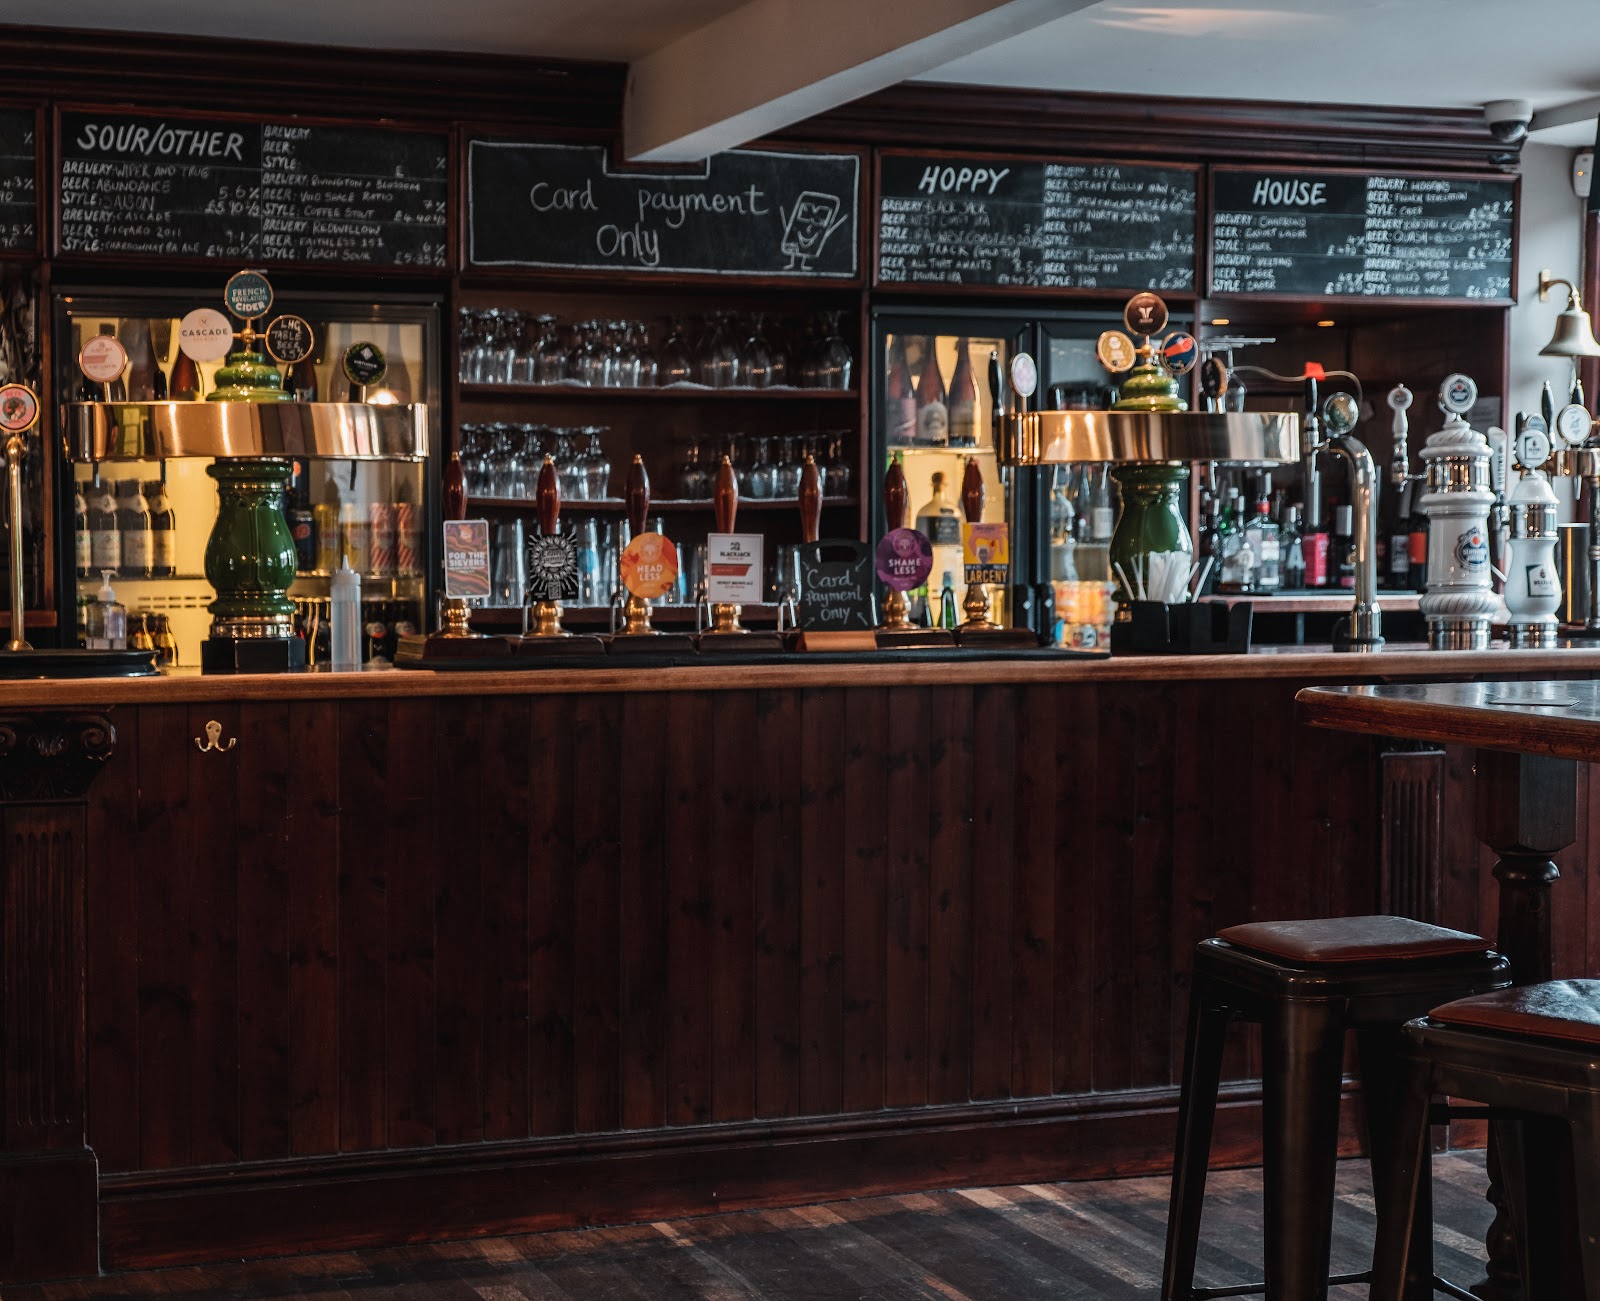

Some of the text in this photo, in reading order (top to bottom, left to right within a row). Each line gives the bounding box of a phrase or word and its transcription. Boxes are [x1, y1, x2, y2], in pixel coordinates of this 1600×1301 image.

[77, 123, 244, 161] SOUR/OTHER
[154, 165, 176, 177] AND
[1092, 167, 1120, 180] DEYA
[918, 165, 1010, 195] HOPPY
[97, 180, 171, 193] ABUNDANCE
[1252, 177, 1327, 206] HOUSE
[362, 190, 394, 202] RATIO
[530, 178, 769, 229] Card payment
[116, 211, 172, 223] CASCADE
[303, 205, 341, 217] COFFEE
[344, 207, 376, 219] STOUT
[156, 226, 182, 239] 2011
[313, 220, 382, 236] REDWILLOW
[1073, 221, 1092, 233] IPA
[182, 241, 201, 253] ALE
[597, 223, 660, 266] Only
[926, 242, 970, 256] TRACK
[306, 247, 338, 259] PEACH
[341, 249, 371, 262] SOUR
[955, 259, 992, 271] AWAITS
[232, 287, 266, 297] FRENCH
[235, 302, 265, 311] CIDER
[182, 328, 228, 337] CASCADE
[271, 329, 302, 340] TABLE
[277, 340, 301, 351] BEER
[448, 551, 485, 560] FOR THE
[637, 564, 663, 573] HEAD
[888, 558, 921, 567] SHAME
[894, 566, 916, 575] LESS
[965, 570, 1007, 583] LARCENY
[639, 573, 661, 581] LESS
[807, 569, 853, 589] Card
[805, 584, 863, 608] payment
[820, 607, 850, 625] Only
